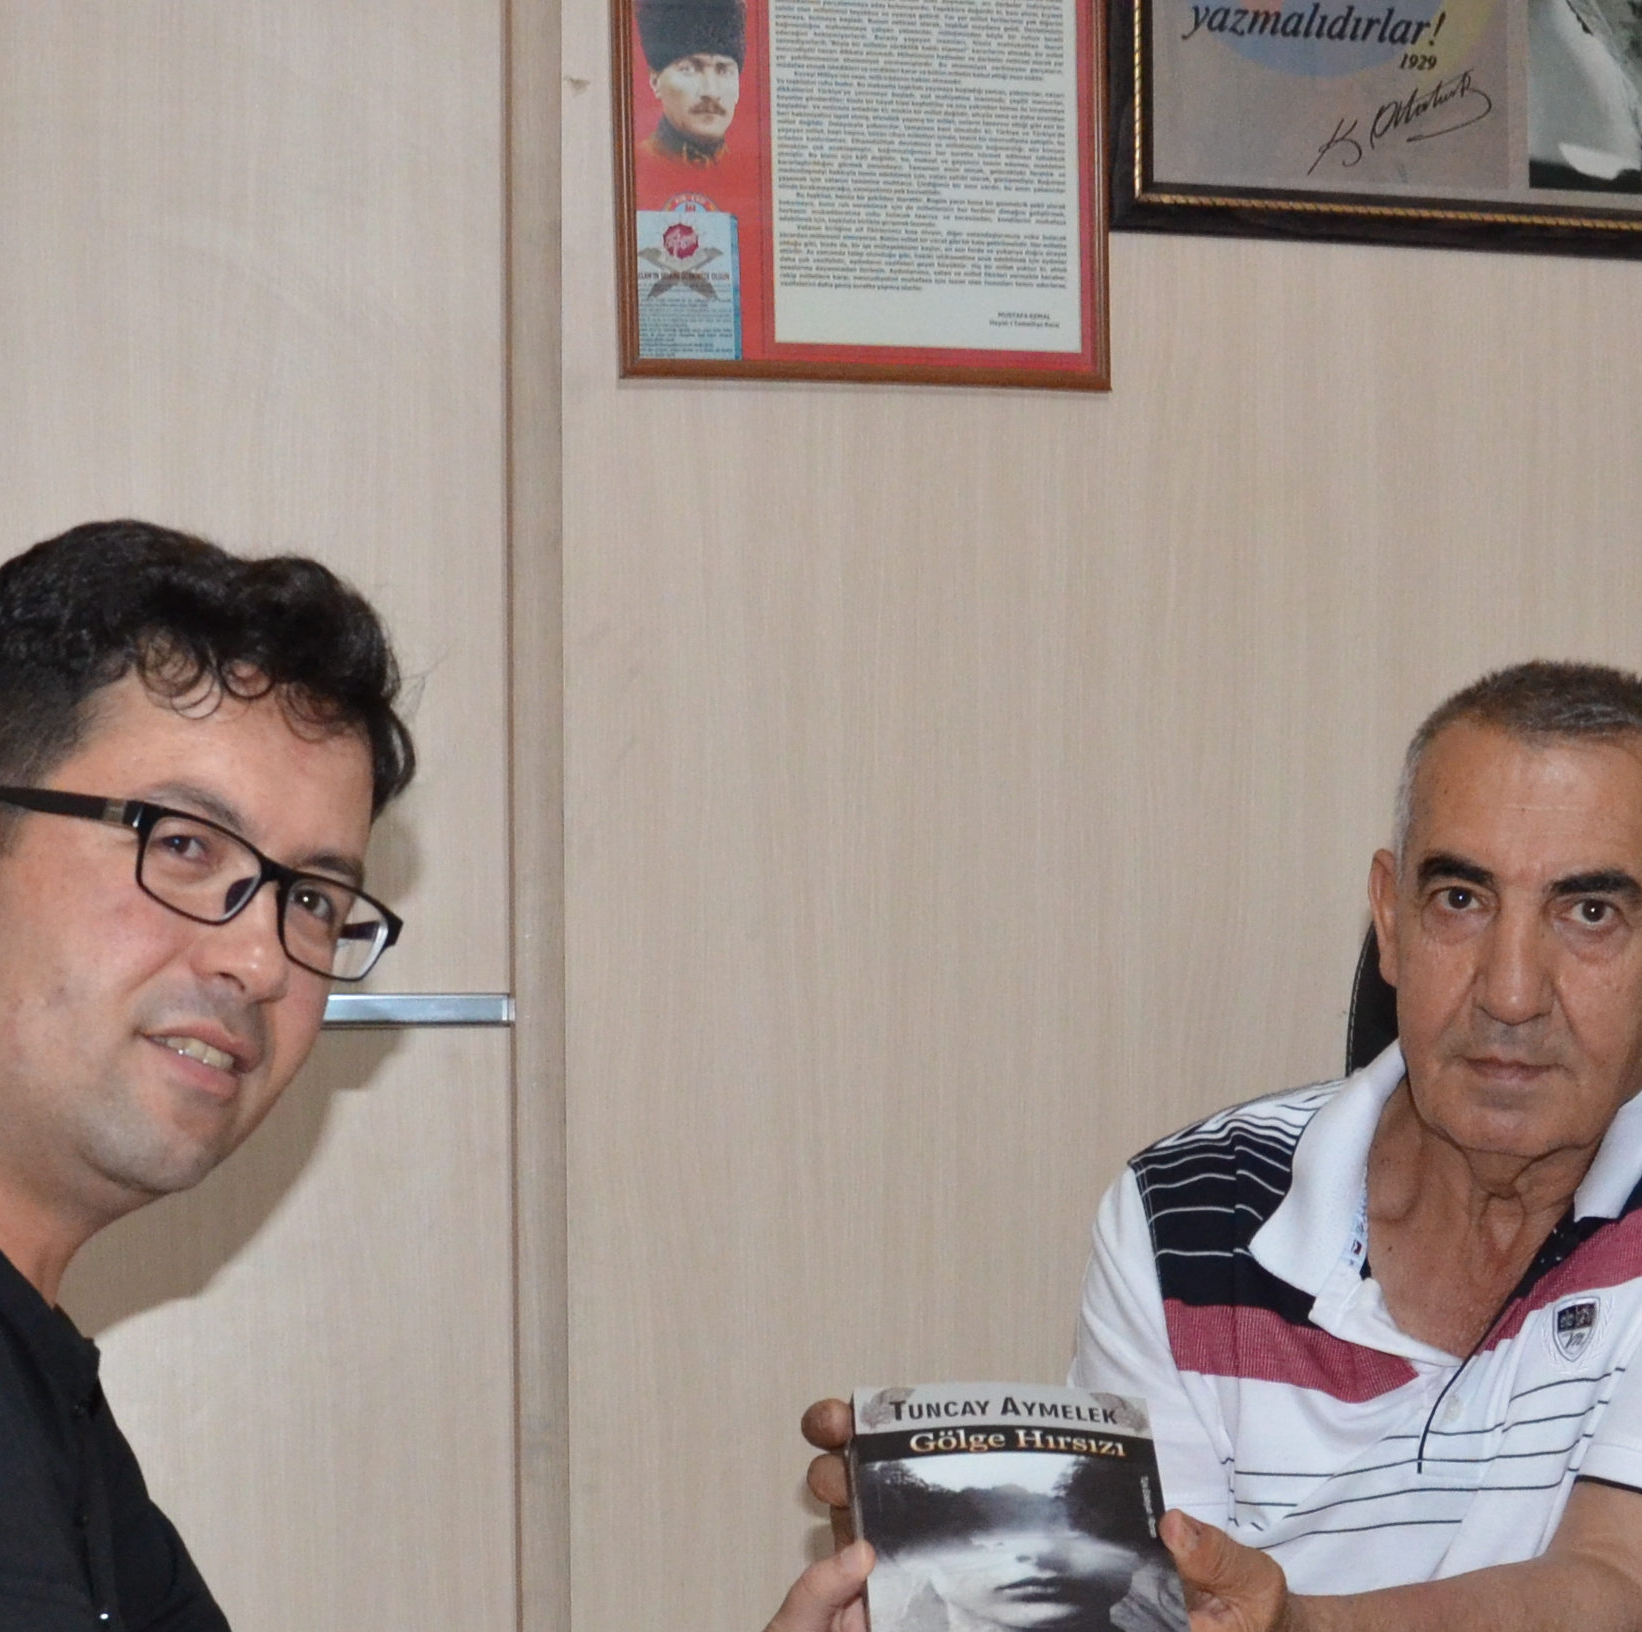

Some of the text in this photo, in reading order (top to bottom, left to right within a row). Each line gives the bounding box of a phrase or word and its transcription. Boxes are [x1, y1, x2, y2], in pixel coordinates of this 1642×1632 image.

[1180, 1, 1446, 46] yazmalıdırlar!
[1398, 53, 1438, 70] 1929
[888, 1396, 1119, 1425] TUNCAY AYMELEK
[909, 1428, 1127, 1457] Gölge Hırsızı
